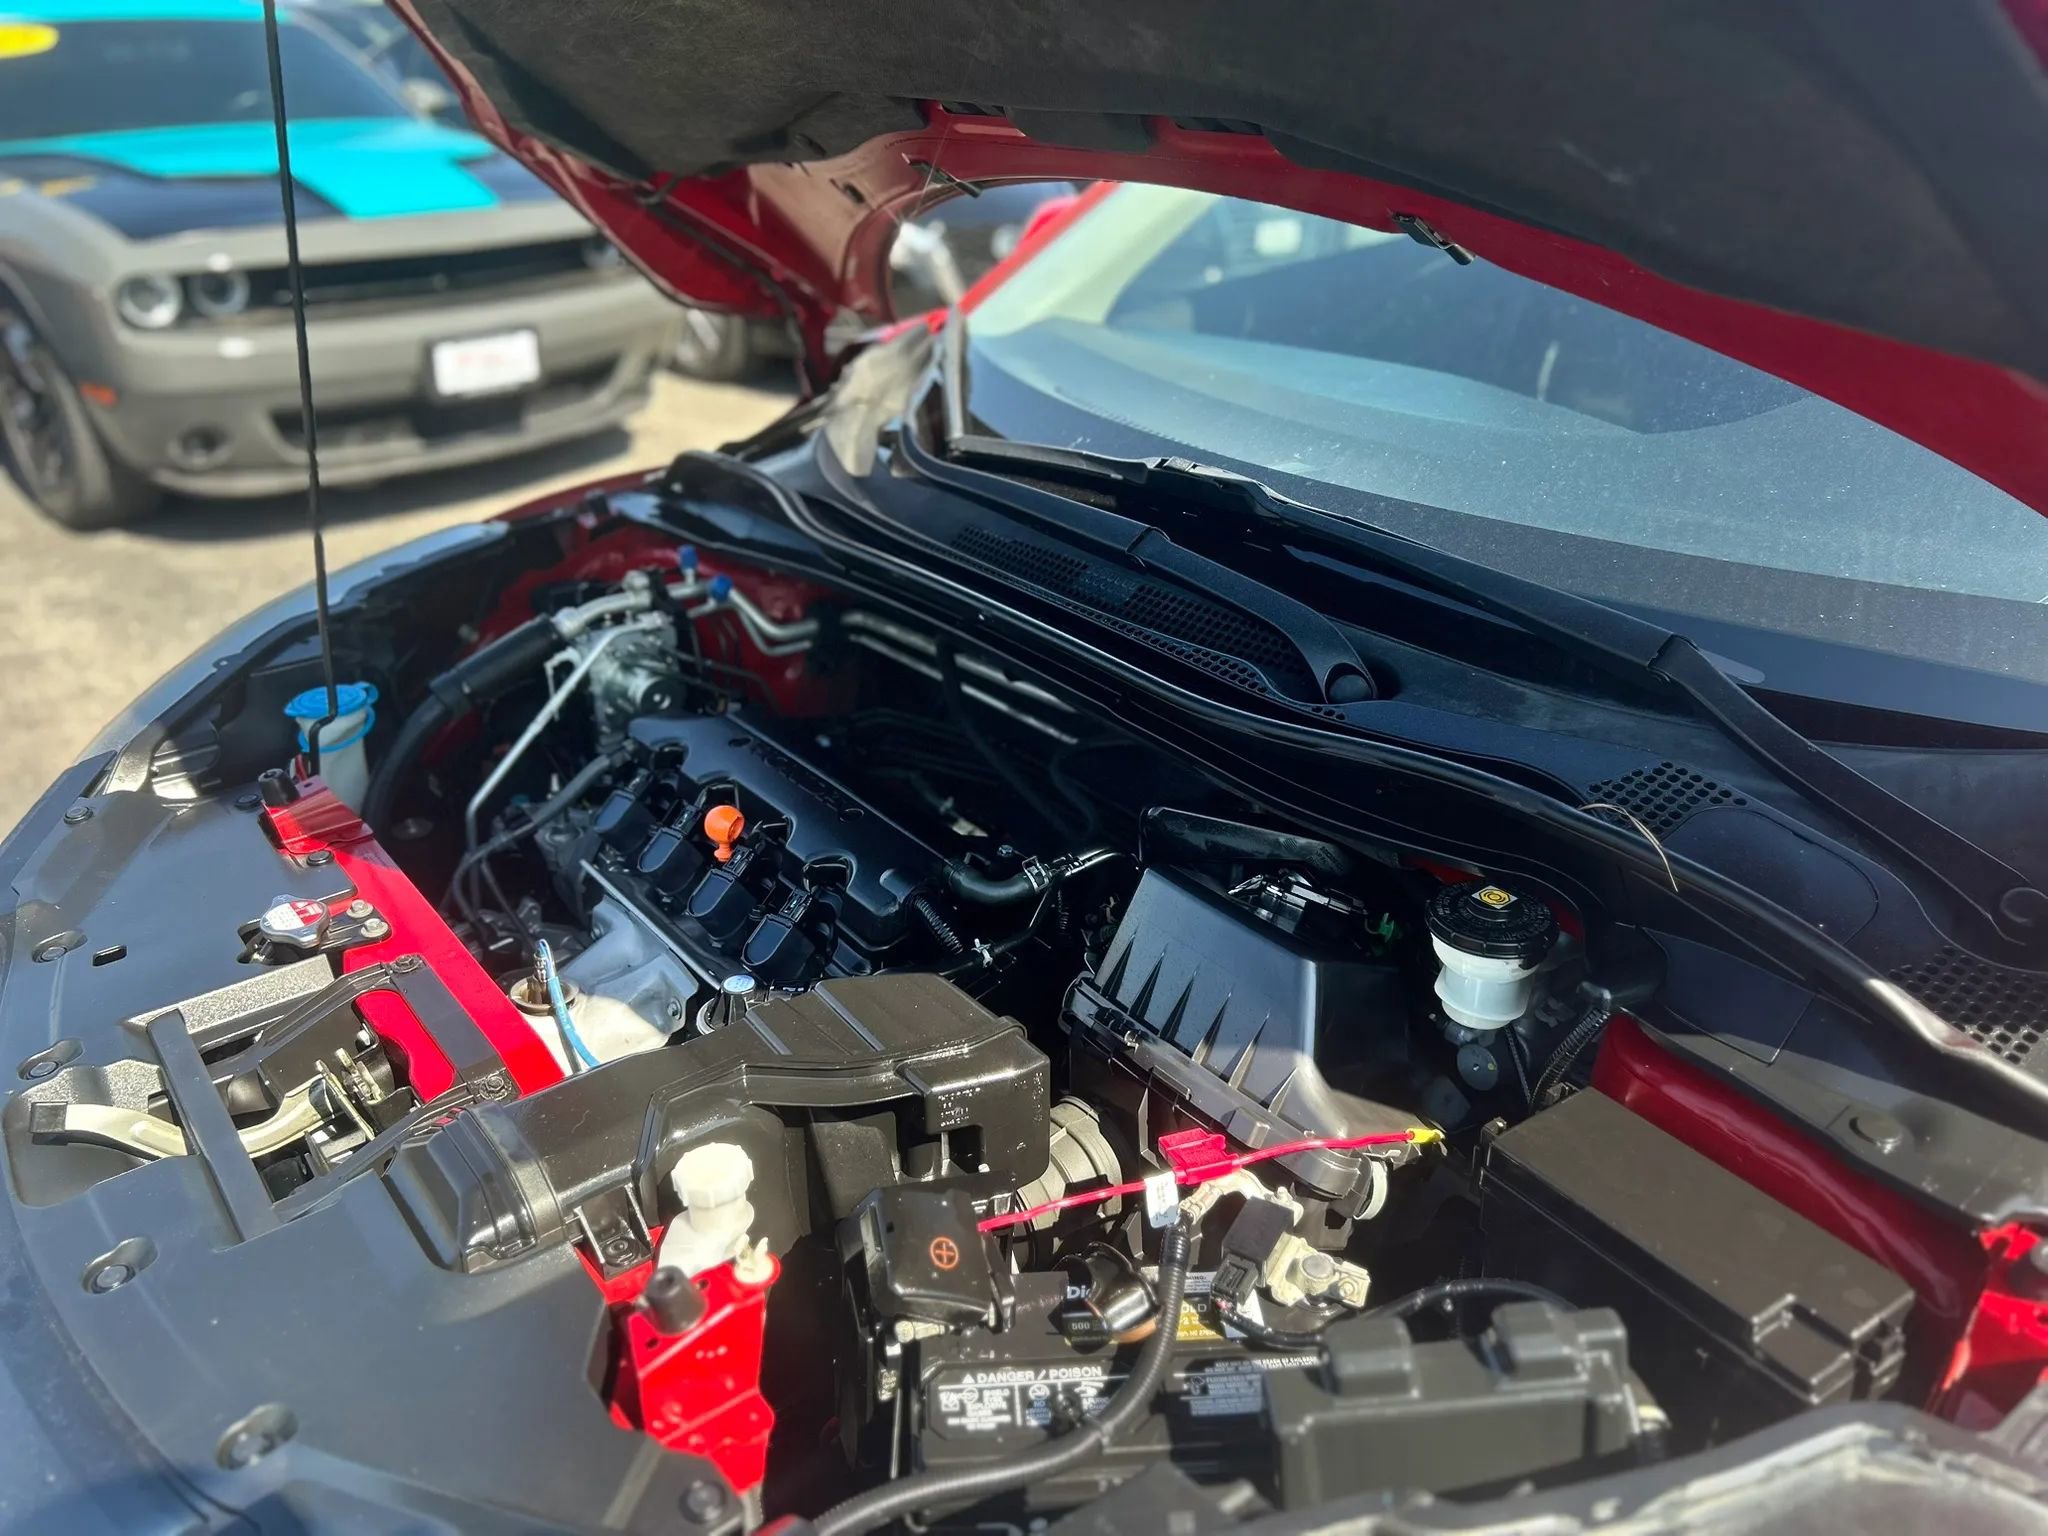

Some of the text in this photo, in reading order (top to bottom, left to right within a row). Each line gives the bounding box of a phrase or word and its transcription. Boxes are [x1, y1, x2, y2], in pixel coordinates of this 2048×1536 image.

[977, 1366, 1102, 1384] DANGER / POISON
